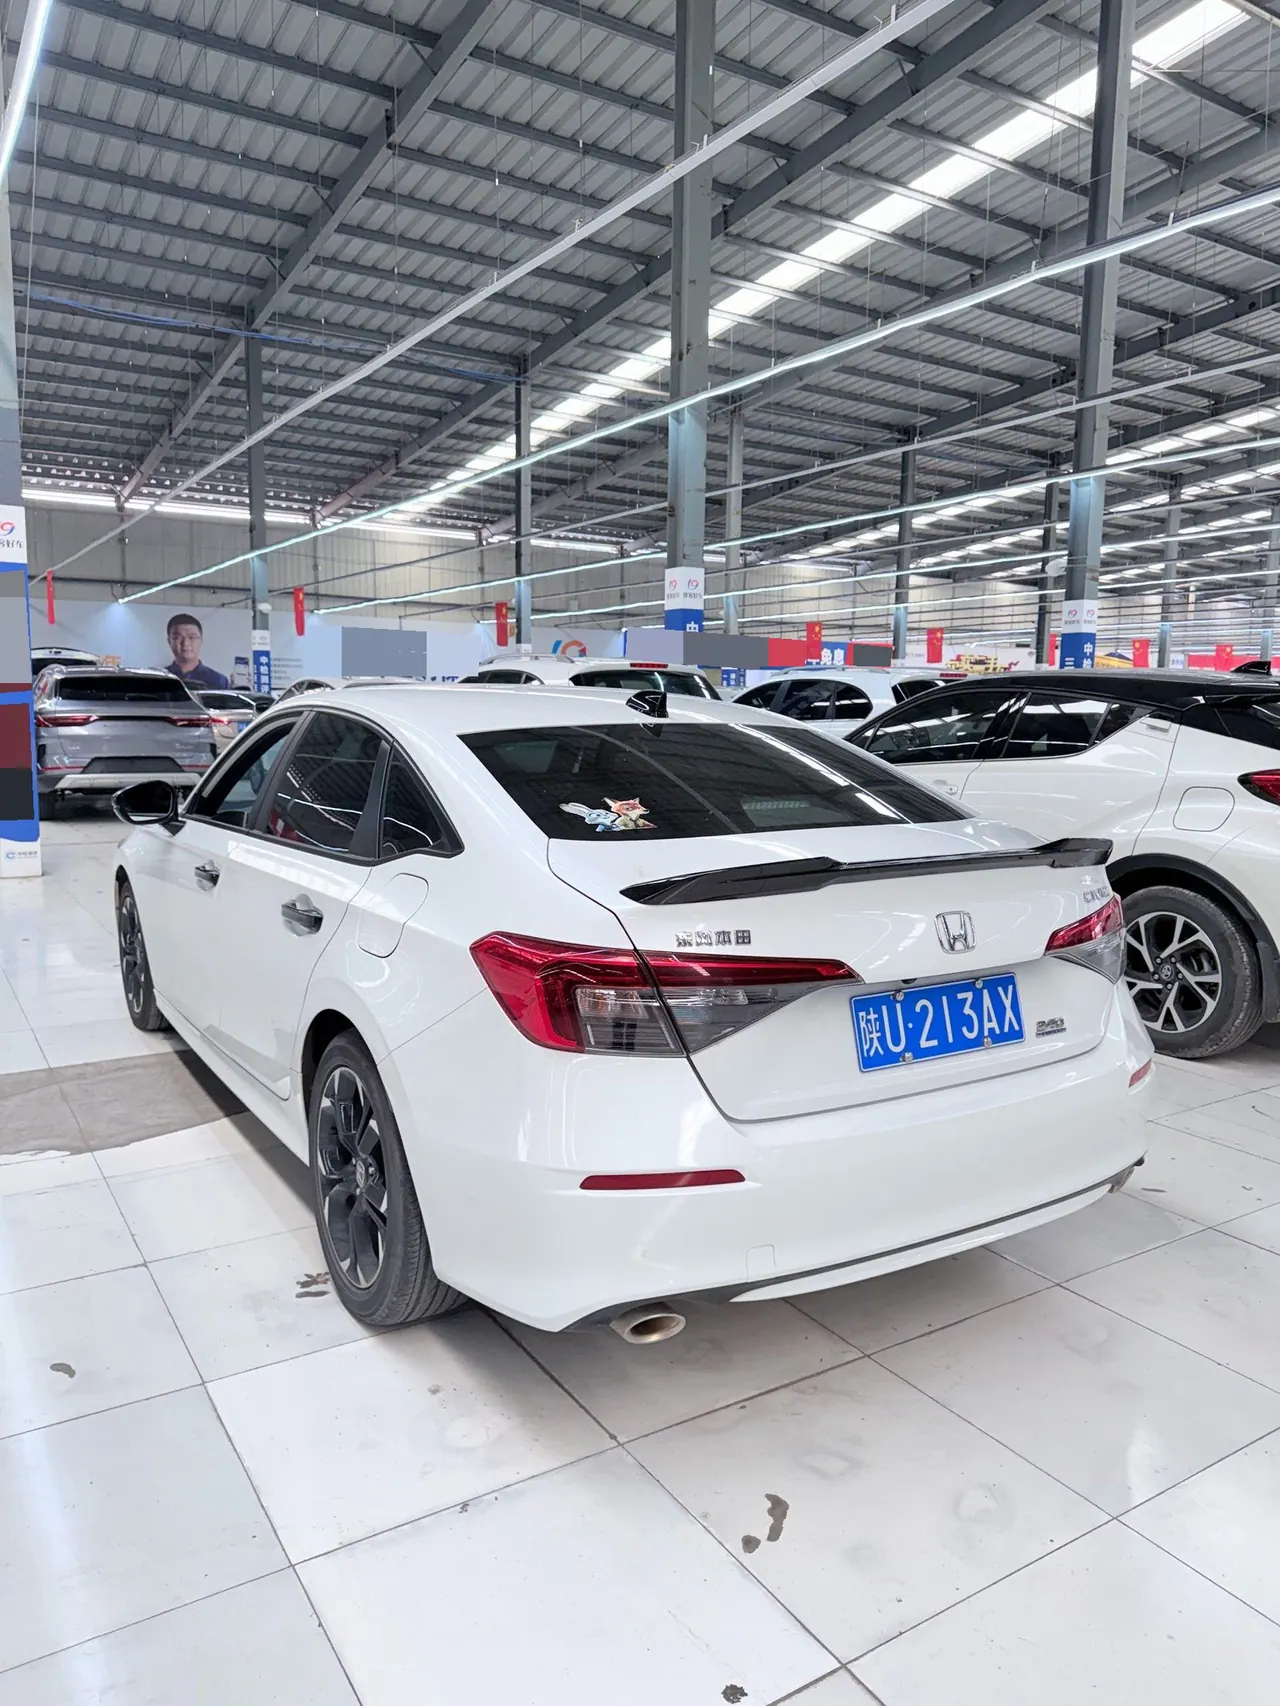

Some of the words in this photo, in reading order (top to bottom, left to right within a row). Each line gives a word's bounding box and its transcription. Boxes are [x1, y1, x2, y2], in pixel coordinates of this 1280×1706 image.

[805, 648, 845, 665] 免息
[675, 930, 751, 948] 东风本田
